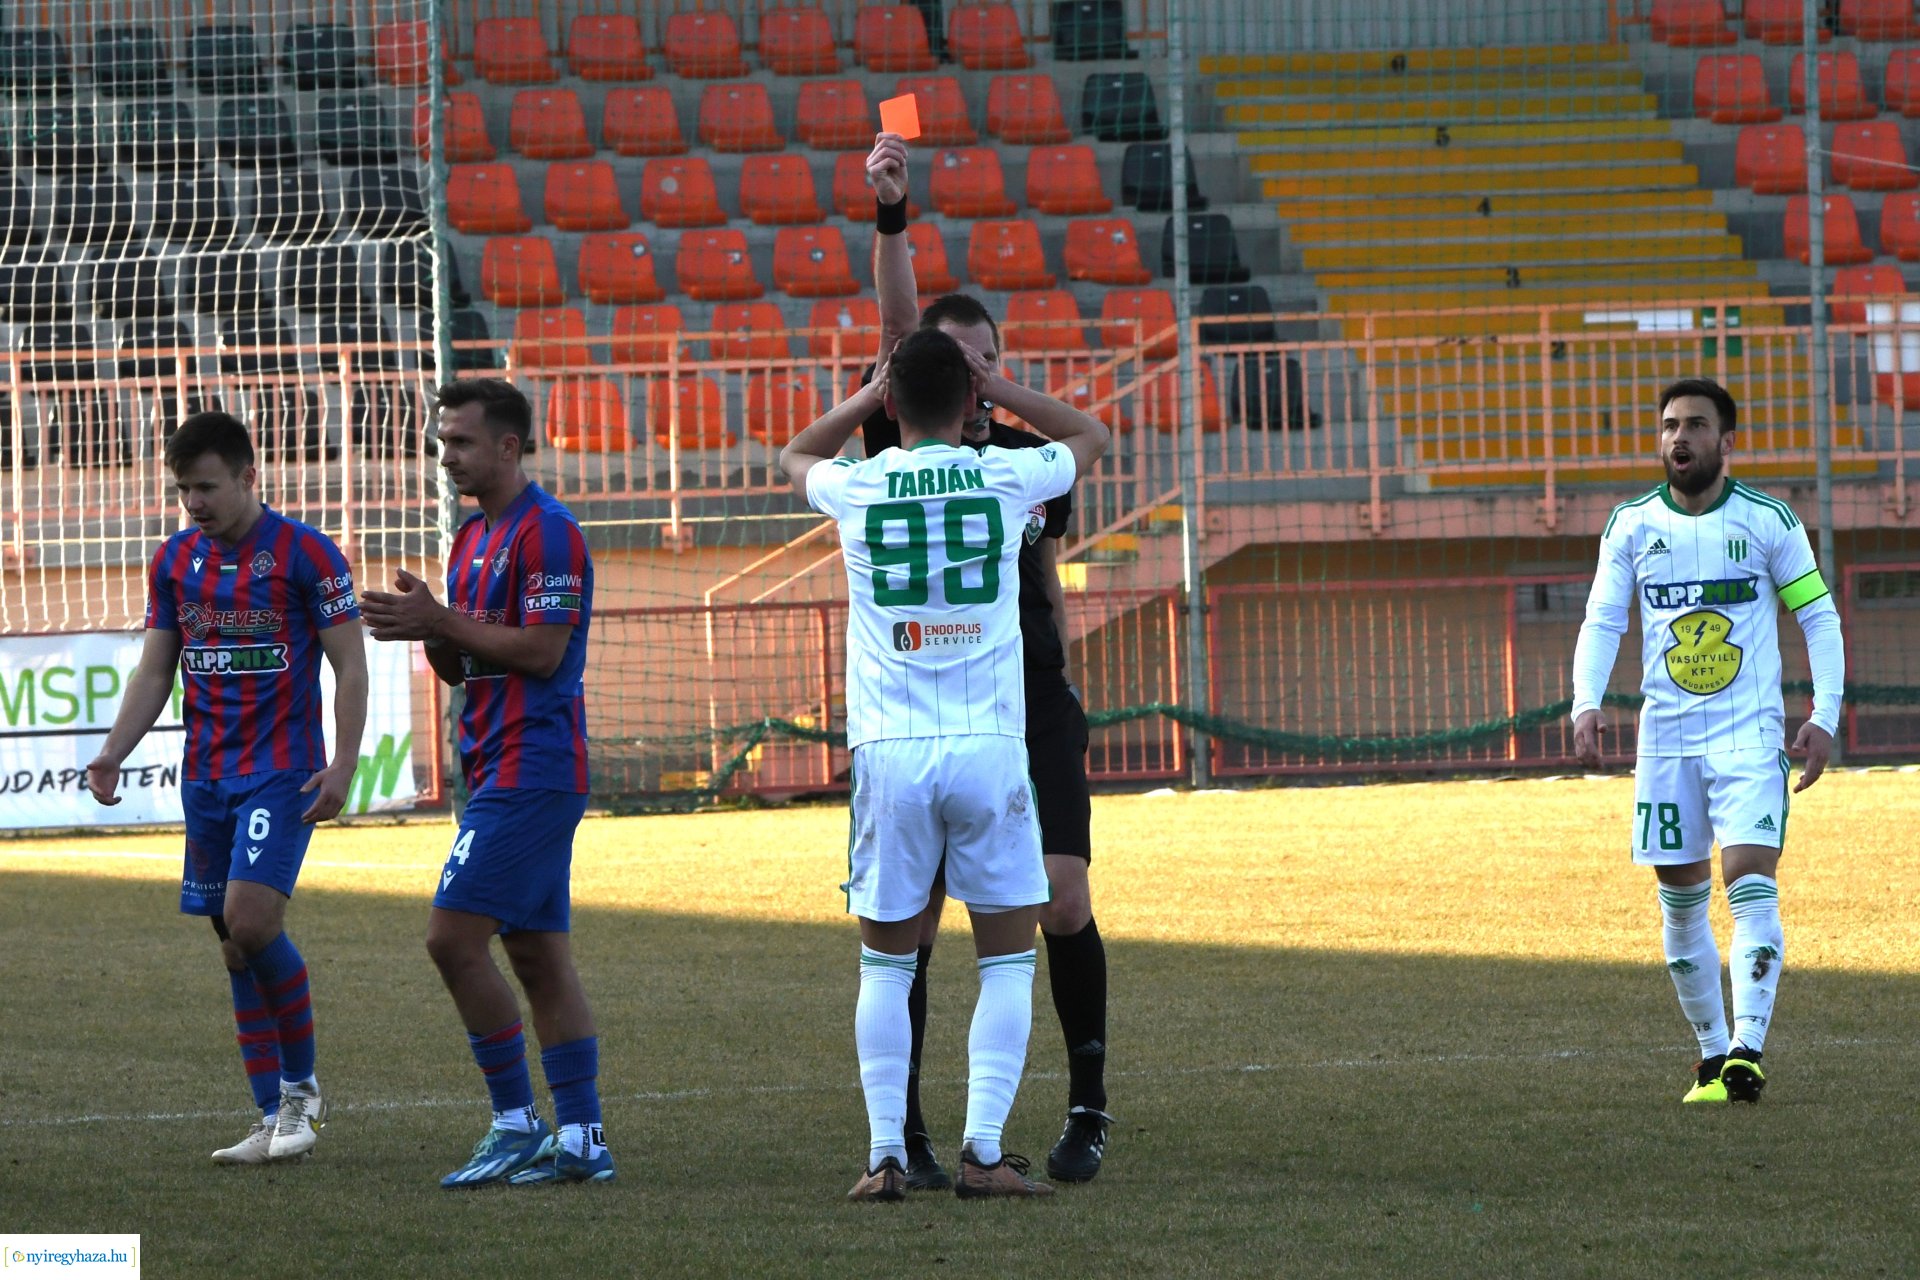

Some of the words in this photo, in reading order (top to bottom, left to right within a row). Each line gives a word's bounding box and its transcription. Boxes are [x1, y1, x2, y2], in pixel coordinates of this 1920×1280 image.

[885, 463, 985, 498] TARJÁN
[865, 497, 1004, 607] 99
[1680, 624, 1691, 634] 19
[1709, 623, 1721, 633] 49
[924, 636, 982, 645] SERVICE
[1670, 652, 1737, 664] VASÚTVILL
[1691, 666, 1715, 676] KFT
[1682, 677, 1726, 690] BUDAPEST
[248, 808, 271, 841] 6
[1637, 802, 1683, 850] 78
